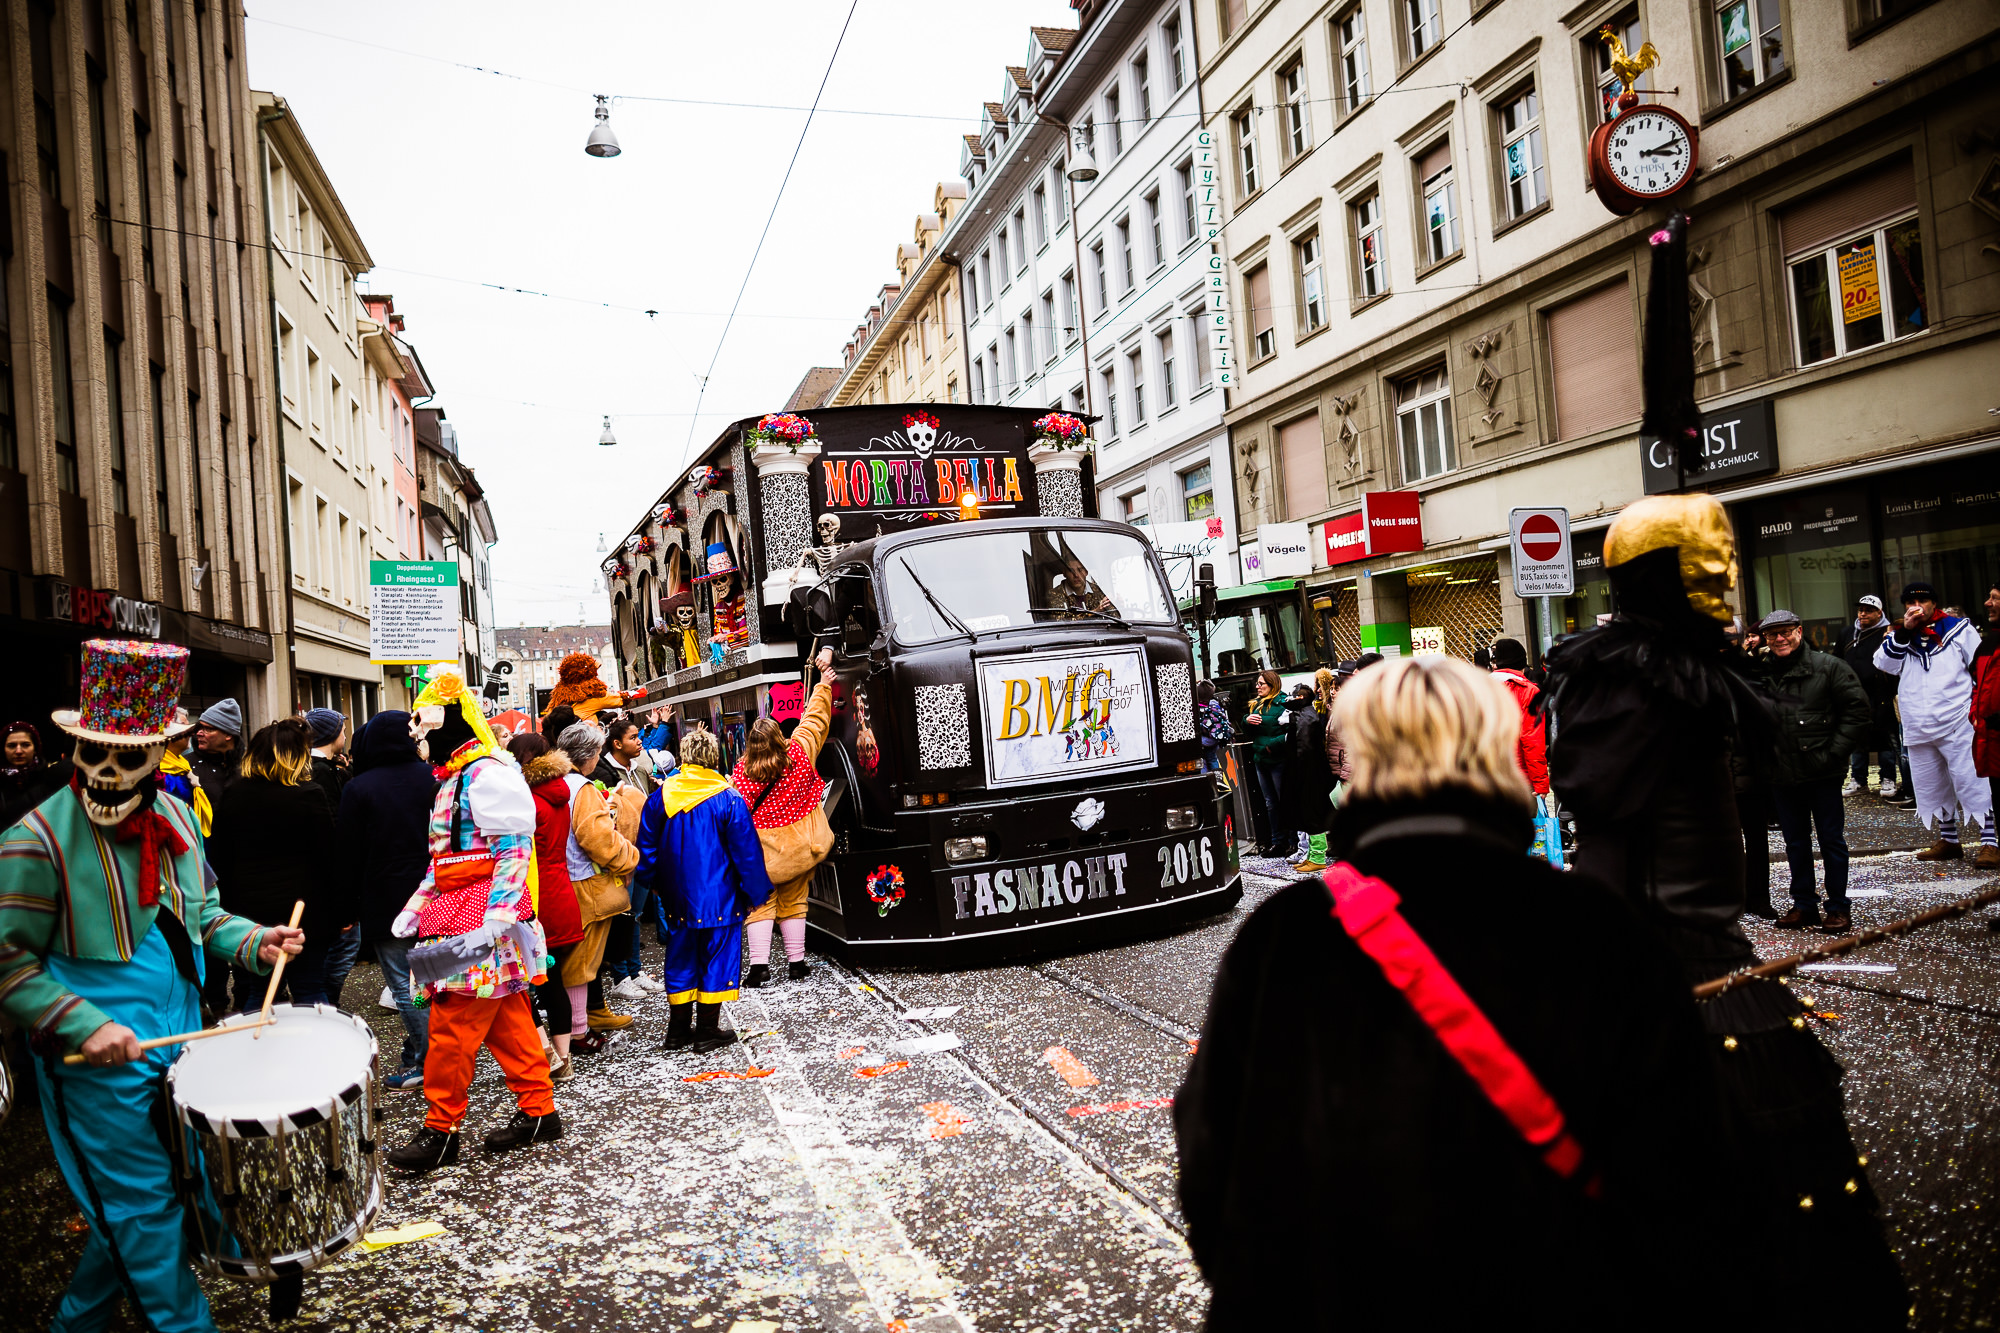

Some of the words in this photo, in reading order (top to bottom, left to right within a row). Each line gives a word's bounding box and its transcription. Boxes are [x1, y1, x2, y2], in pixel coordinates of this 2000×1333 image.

[1639, 117, 1651, 129] 12
[1657, 121, 1663, 131] 1
[1626, 125, 1635, 135] 11
[1614, 138, 1628, 148] 10
[1614, 151, 1622, 162] 9
[1621, 166, 1628, 177] 8
[1664, 172, 1670, 183] 5
[1633, 176, 1639, 186] 7
[1648, 177, 1656, 188] 6
[1198, 132, 1217, 238] Gryffe
[1210, 256, 1229, 383] Galerie
[1844, 287, 1879, 309] 20.-
[1649, 419, 1741, 469] CIST
[1717, 450, 1760, 468] SCHMUCK
[822, 459, 930, 507] MORTA
[934, 457, 1024, 504] BELLA
[1886, 501, 1912, 515] Louis
[1371, 517, 1396, 527] VÖGELE
[1398, 517, 1418, 526] SHOES
[1760, 521, 1792, 535] RADO
[1803, 520, 1832, 530] FREDERIQUE
[1832, 515, 1858, 526] CONSTANT
[1267, 545, 1306, 555] Vögele
[1245, 555, 1261, 570] Vö
[1576, 556, 1601, 567] TISSOT
[1521, 564, 1565, 572] ausgenommen
[385, 573, 392, 583] D
[396, 575, 436, 584] Rheingasse
[437, 574, 445, 583] D
[70, 586, 113, 630] BPS
[1066, 663, 1104, 678] BASLER
[1065, 683, 1141, 703] GESELLSCHAFT
[777, 699, 802, 711] 207
[996, 668, 1112, 741] BMG
[1110, 697, 1132, 710] 1907
[951, 852, 1128, 920] FASNACHT
[1157, 836, 1215, 889] 2016
